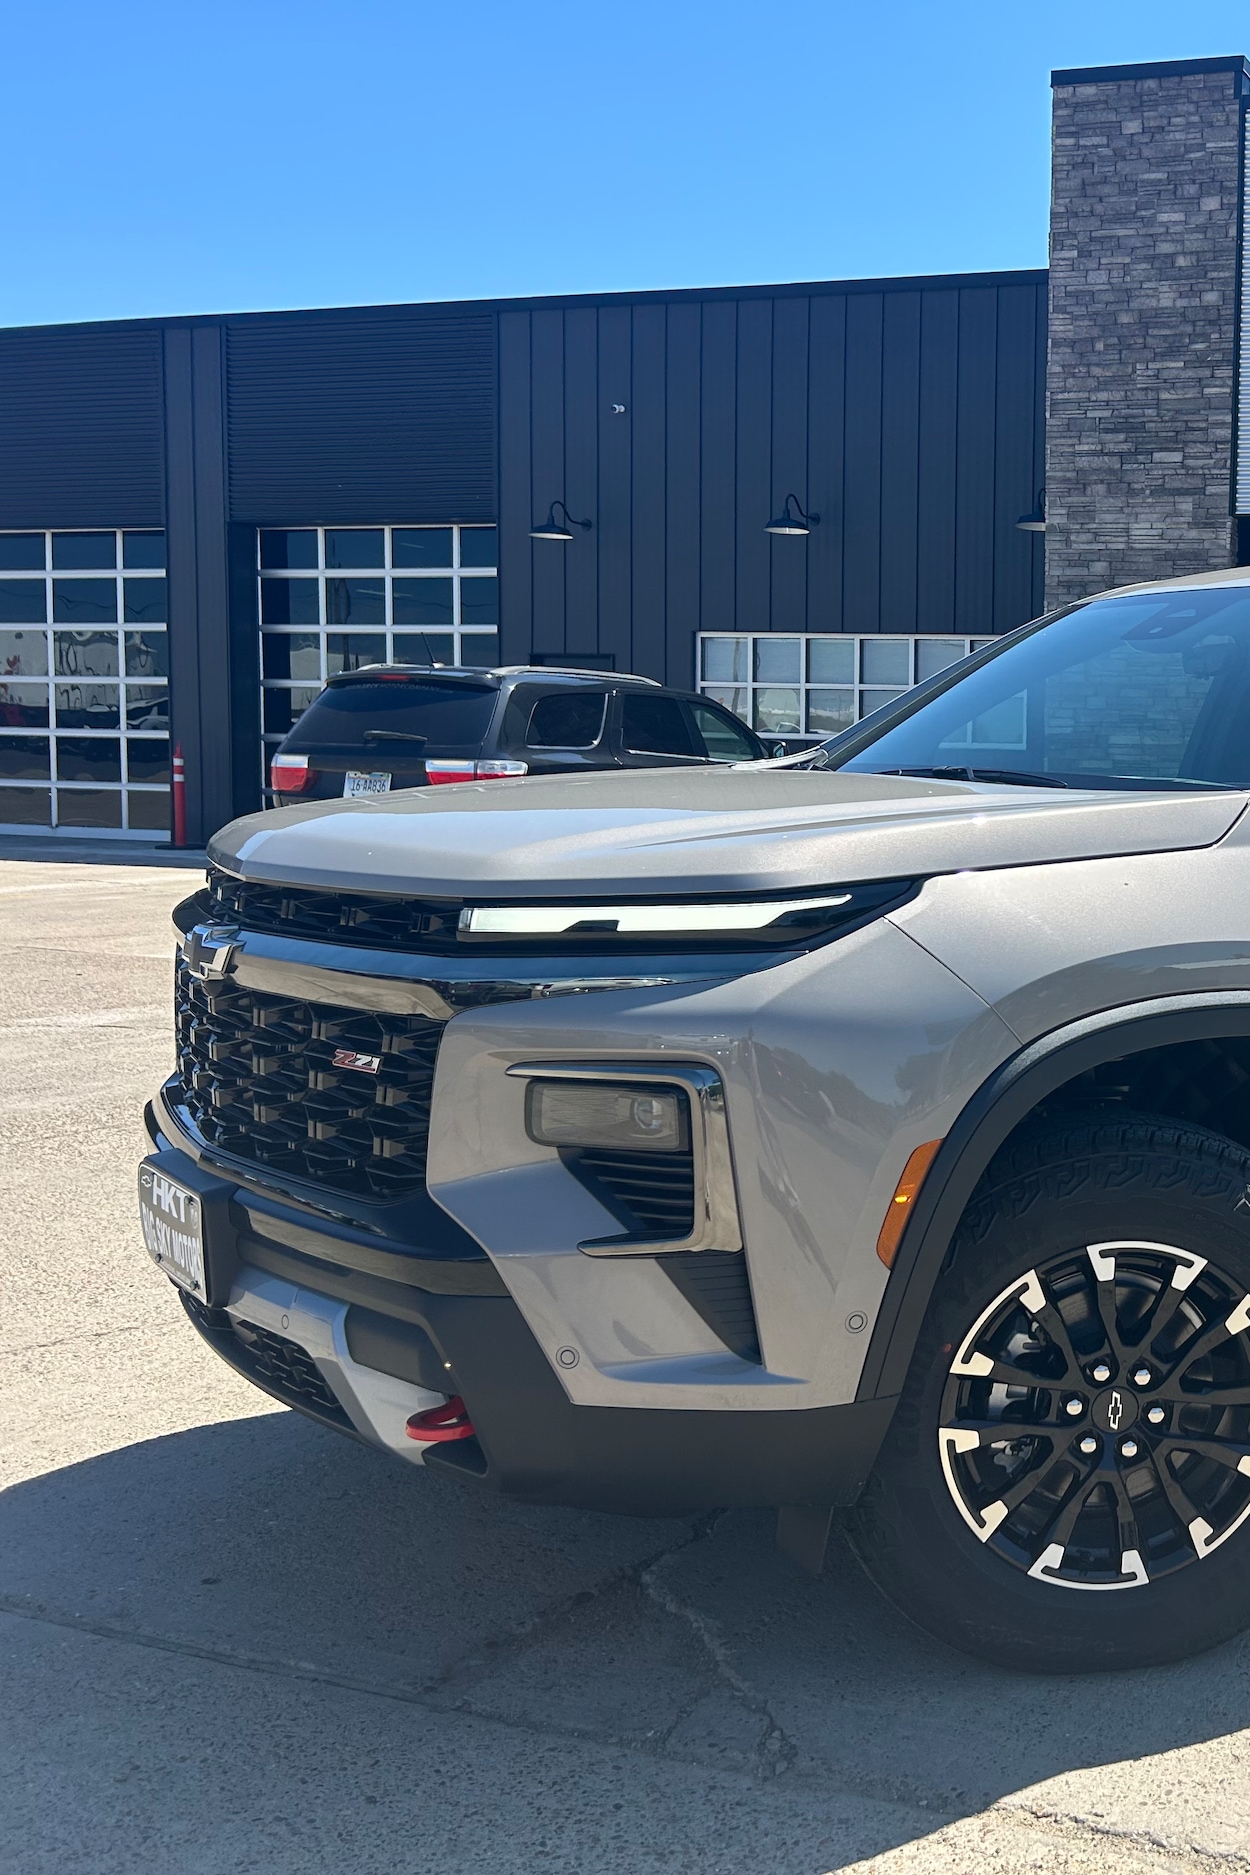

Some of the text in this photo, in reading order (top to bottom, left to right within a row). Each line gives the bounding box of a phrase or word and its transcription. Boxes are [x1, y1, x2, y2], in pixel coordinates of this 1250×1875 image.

[332, 1049, 380, 1074] Z71
[152, 1174, 187, 1223] HKT
[142, 1201, 158, 1251] BIG
[156, 1216, 172, 1258] SKY
[172, 1229, 203, 1289] MOTORS
